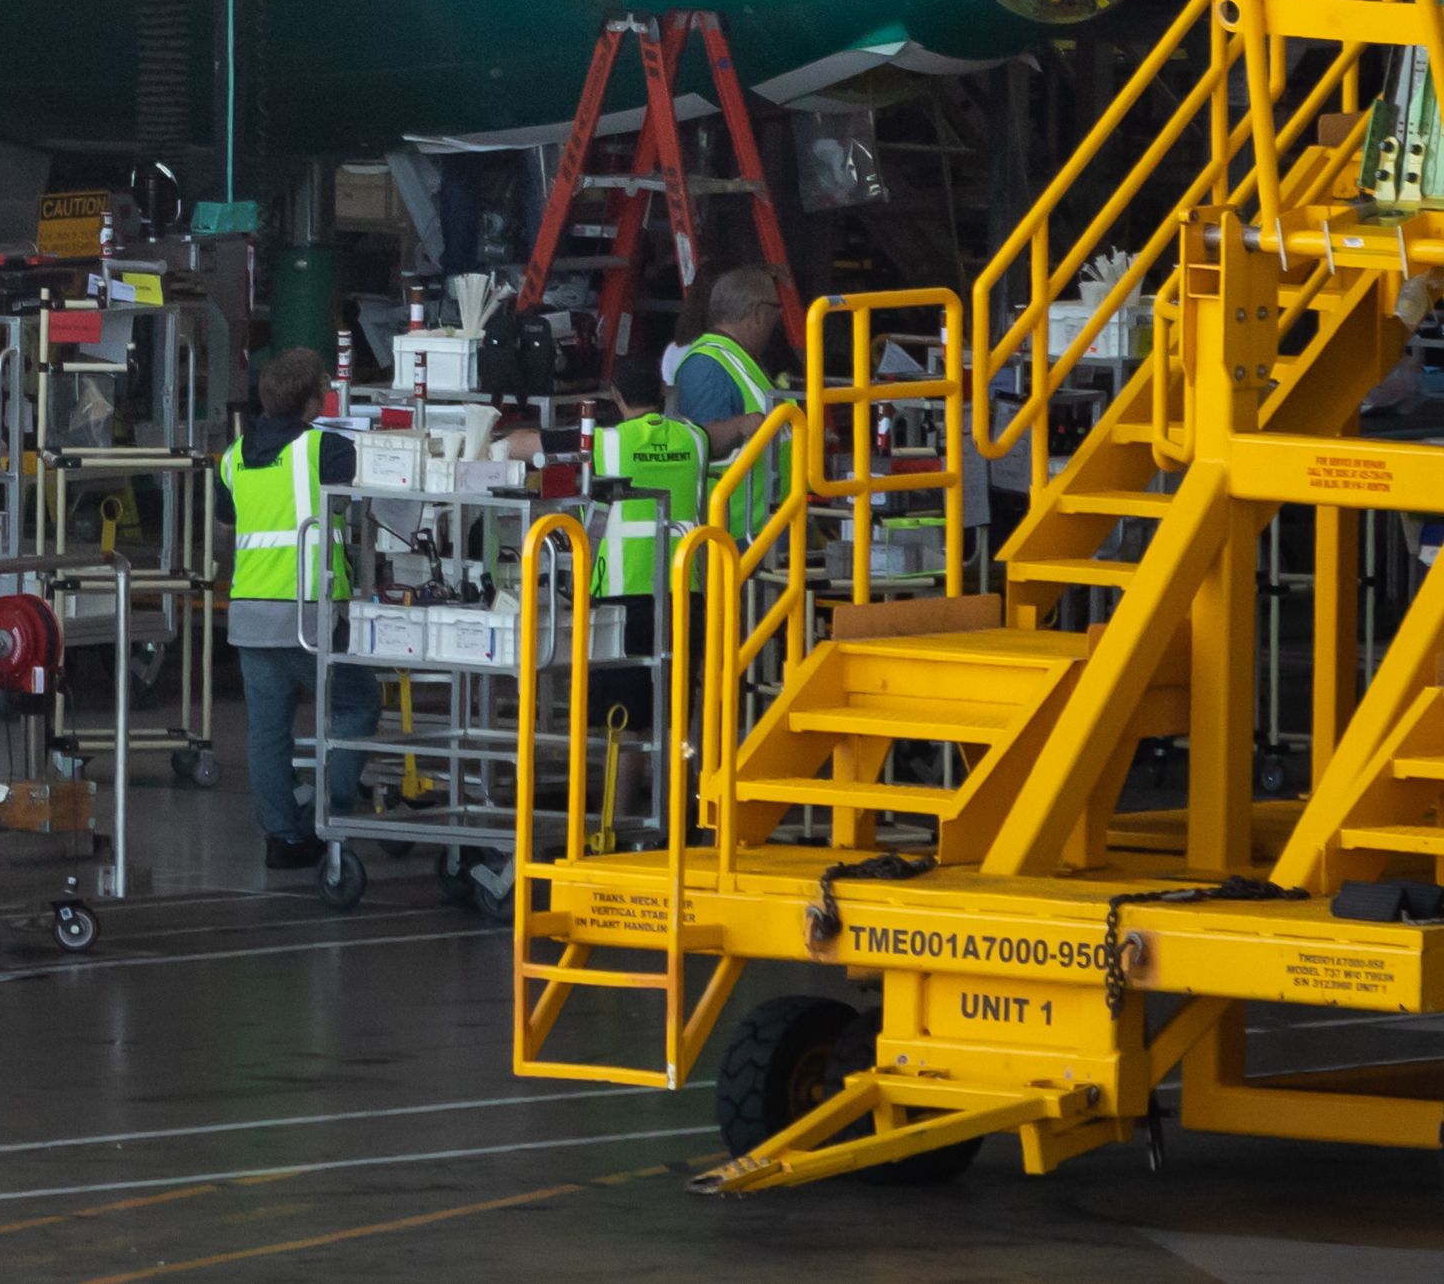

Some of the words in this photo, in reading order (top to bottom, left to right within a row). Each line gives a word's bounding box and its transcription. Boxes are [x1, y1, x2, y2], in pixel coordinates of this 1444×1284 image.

[43, 196, 108, 219] CAUTION
[591, 906, 637, 918] VERTICAL
[576, 918, 587, 927] IN
[590, 918, 620, 929] PLANT
[849, 925, 1110, 970] TME001A7000-950
[1285, 965, 1319, 976] MODEL
[960, 993, 1030, 1023] UNIT
[1040, 1000, 1052, 1026] 1
